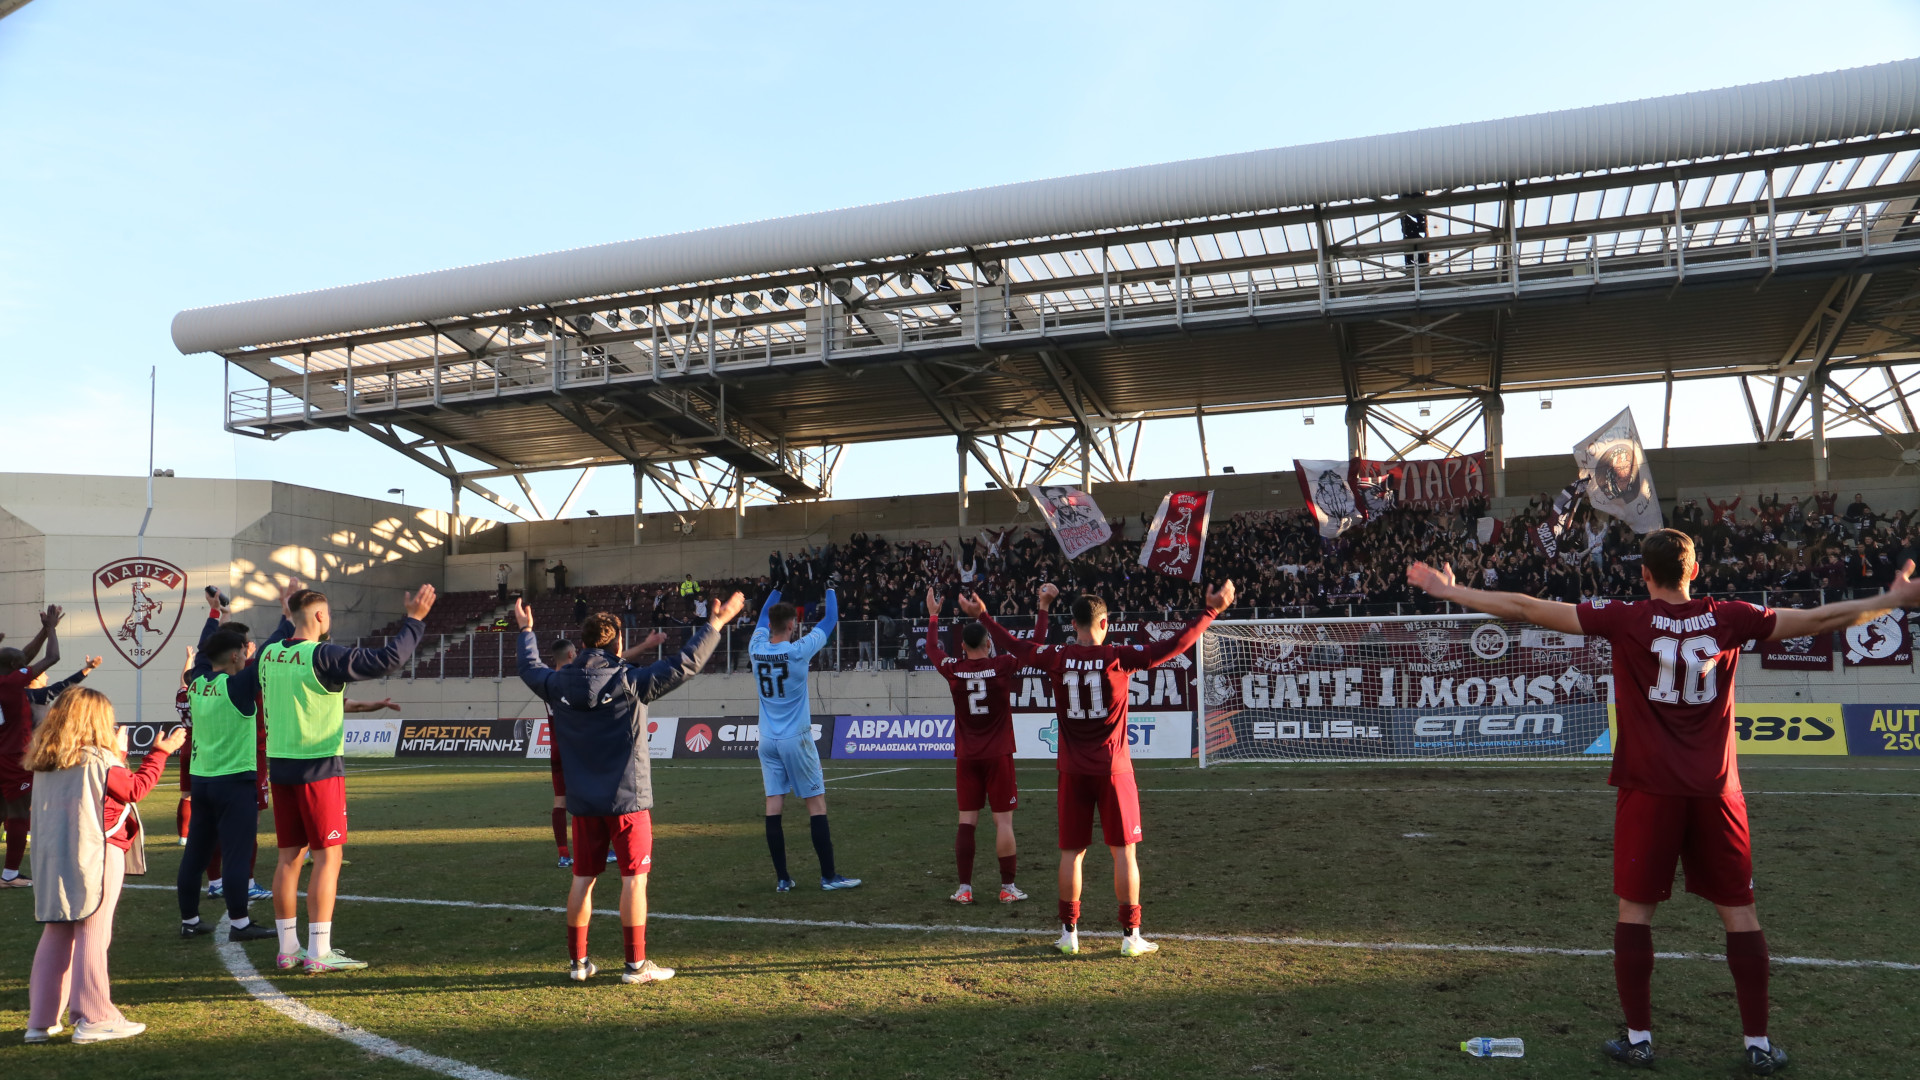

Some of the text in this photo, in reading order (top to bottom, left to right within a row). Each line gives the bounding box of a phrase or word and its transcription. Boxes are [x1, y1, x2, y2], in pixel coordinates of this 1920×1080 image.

[106, 564, 175, 584] ΛΑΡΙΣΑ
[1479, 633, 1501, 651] 82
[128, 648, 152, 656] 1964
[1065, 658, 1104, 671] NINO
[1408, 660, 1463, 673] MONSTERS
[1648, 634, 1720, 705] 16
[757, 662, 789, 698] 67
[1241, 667, 1396, 708] GATE 1
[966, 679, 990, 715] 2
[1062, 670, 1108, 719] 11
[1414, 713, 1564, 737] ETEM
[1870, 709, 1920, 732] AUT
[345, 731, 392, 746] 97,8 FM
[404, 726, 491, 738] ΕΛΑΣΤΙΚΑ
[1253, 721, 1352, 739] SOLIS
[401, 739, 524, 752] ΜΠΑΛΟΓΙΑΝΝΗΣ
[859, 743, 917, 752] ΠΑΡΑΔΟΣΙΑΚΑ
